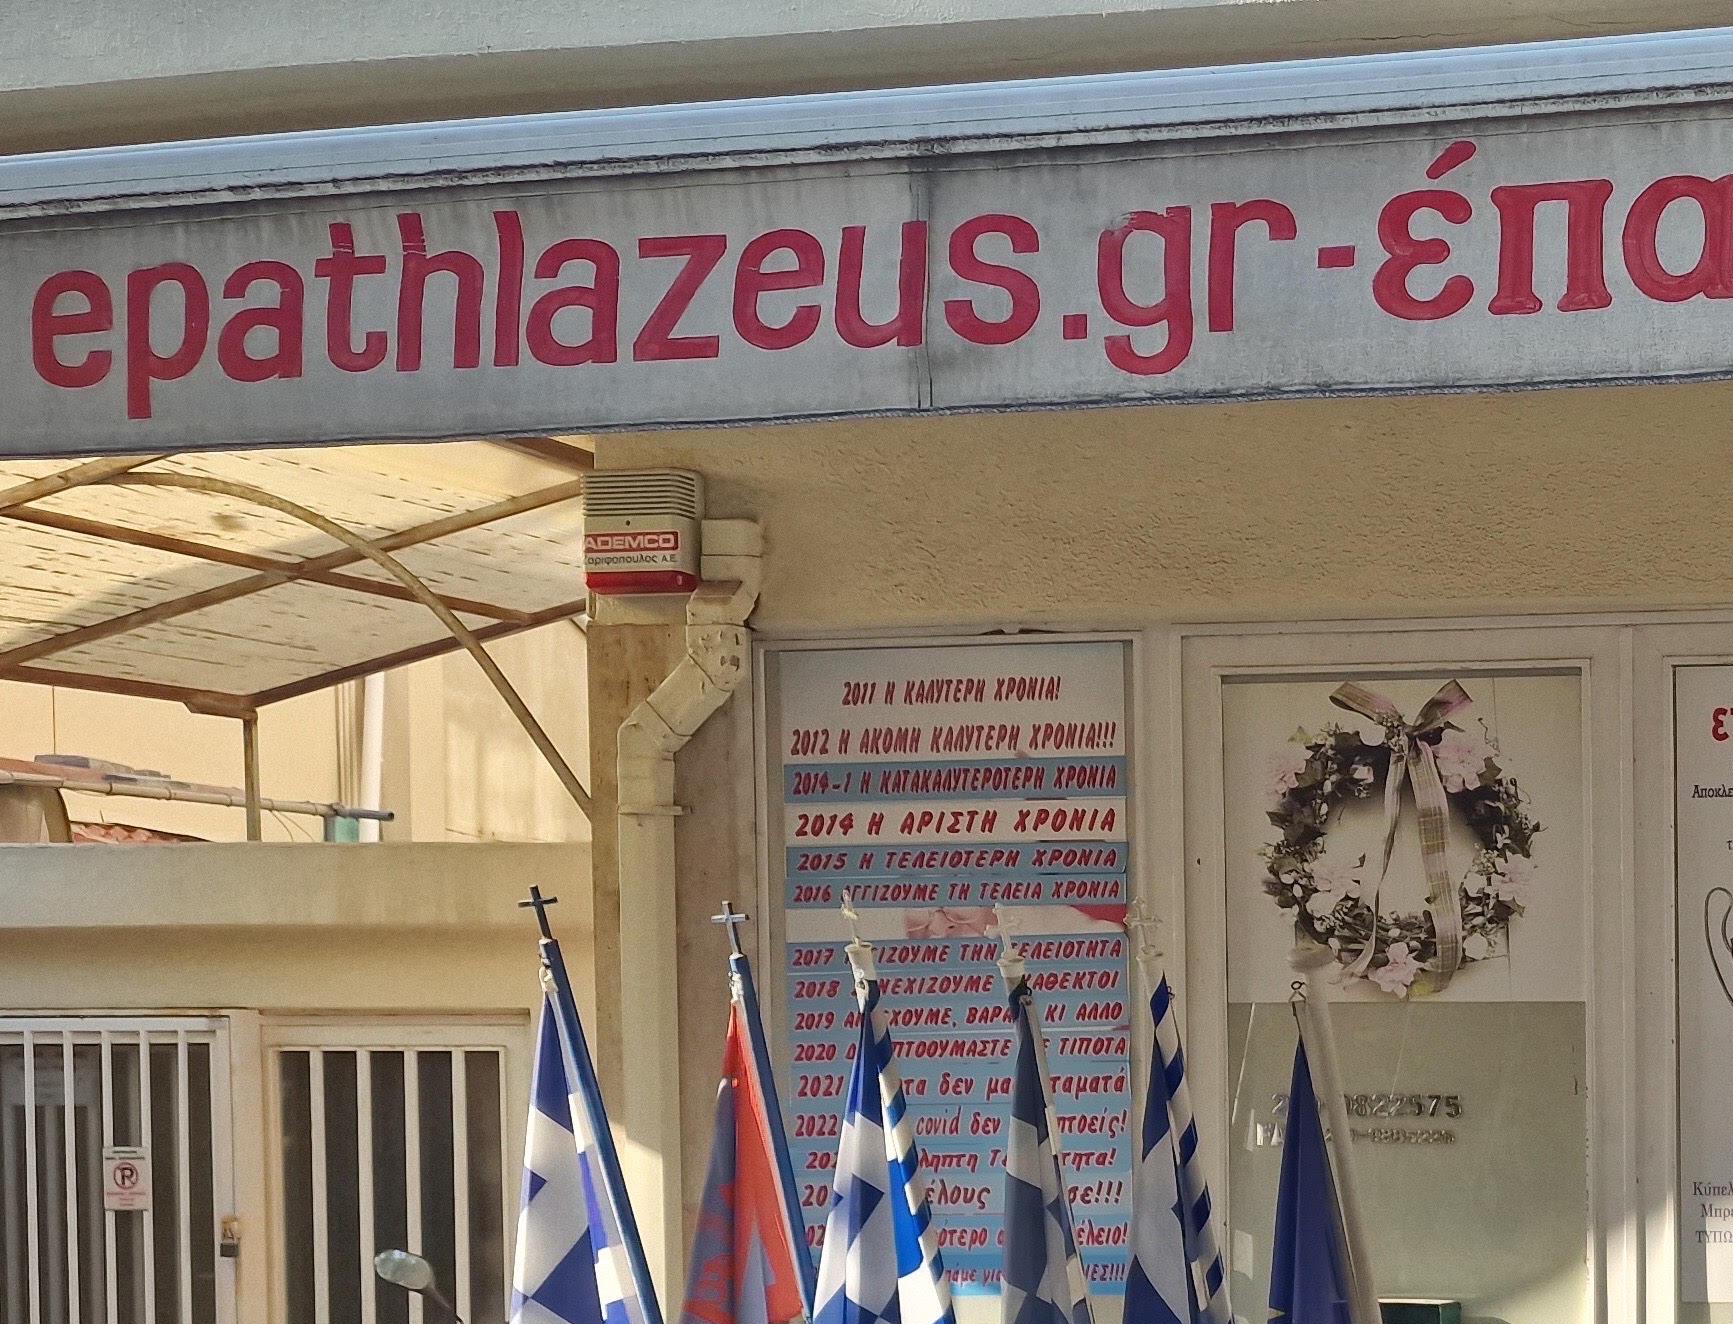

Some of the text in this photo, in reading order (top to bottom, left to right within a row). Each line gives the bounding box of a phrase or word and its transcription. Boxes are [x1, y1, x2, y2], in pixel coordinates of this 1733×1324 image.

[585, 533, 675, 550] ADEMCO
[842, 676, 1061, 706] 2011 Η ΚΑΛΥΤΕΡΗ ΧΡΟΝΙΑ!
[791, 722, 1116, 756] 2012 Η ΑΚΟΜΗ ΚΑΛΥΤΕΡΗ ΧΡΟΝΙΑ!!!
[860, 771, 871, 793] Η
[880, 766, 1045, 794] ΚΑΤΑΚΑΛΥΤΕΡΟΤΕΡΗ
[1053, 765, 1117, 790] ΧΡΟΝΙΑ
[795, 808, 1116, 837] 2014 Η ΑΡΙΣΤΗ ΧΡΟΝΙΑ
[797, 849, 1117, 872] 2015 Η ΤΕΛΕΙΟΤΕΡΗ ΧΡΟΝΙΑ
[794, 884, 831, 903] 2016
[950, 883, 971, 900] ΤΗ
[980, 882, 1042, 900] ΤΕΛΕΙΑ
[1051, 880, 1120, 899] ΧΡΟΝΙΑ
[793, 948, 834, 966] 2017
[960, 942, 997, 961] ΤΗΝ
[794, 979, 840, 999] 2018
[794, 1011, 835, 1030] 2019
[1045, 1003, 1066, 1022] ΚΙ
[1075, 1001, 1123, 1021] ΑΛΛΟ
[794, 1042, 837, 1062] 2020
[1059, 1036, 1127, 1055] ΤΙΠΟΤΑ
[797, 1074, 844, 1097] 2021
[939, 1072, 974, 1096] δεν
[1050, 1066, 1126, 1100] ταματά
[795, 1114, 838, 1137] 2022
[916, 1105, 962, 1136] covid
[970, 1111, 1002, 1136] δεν
